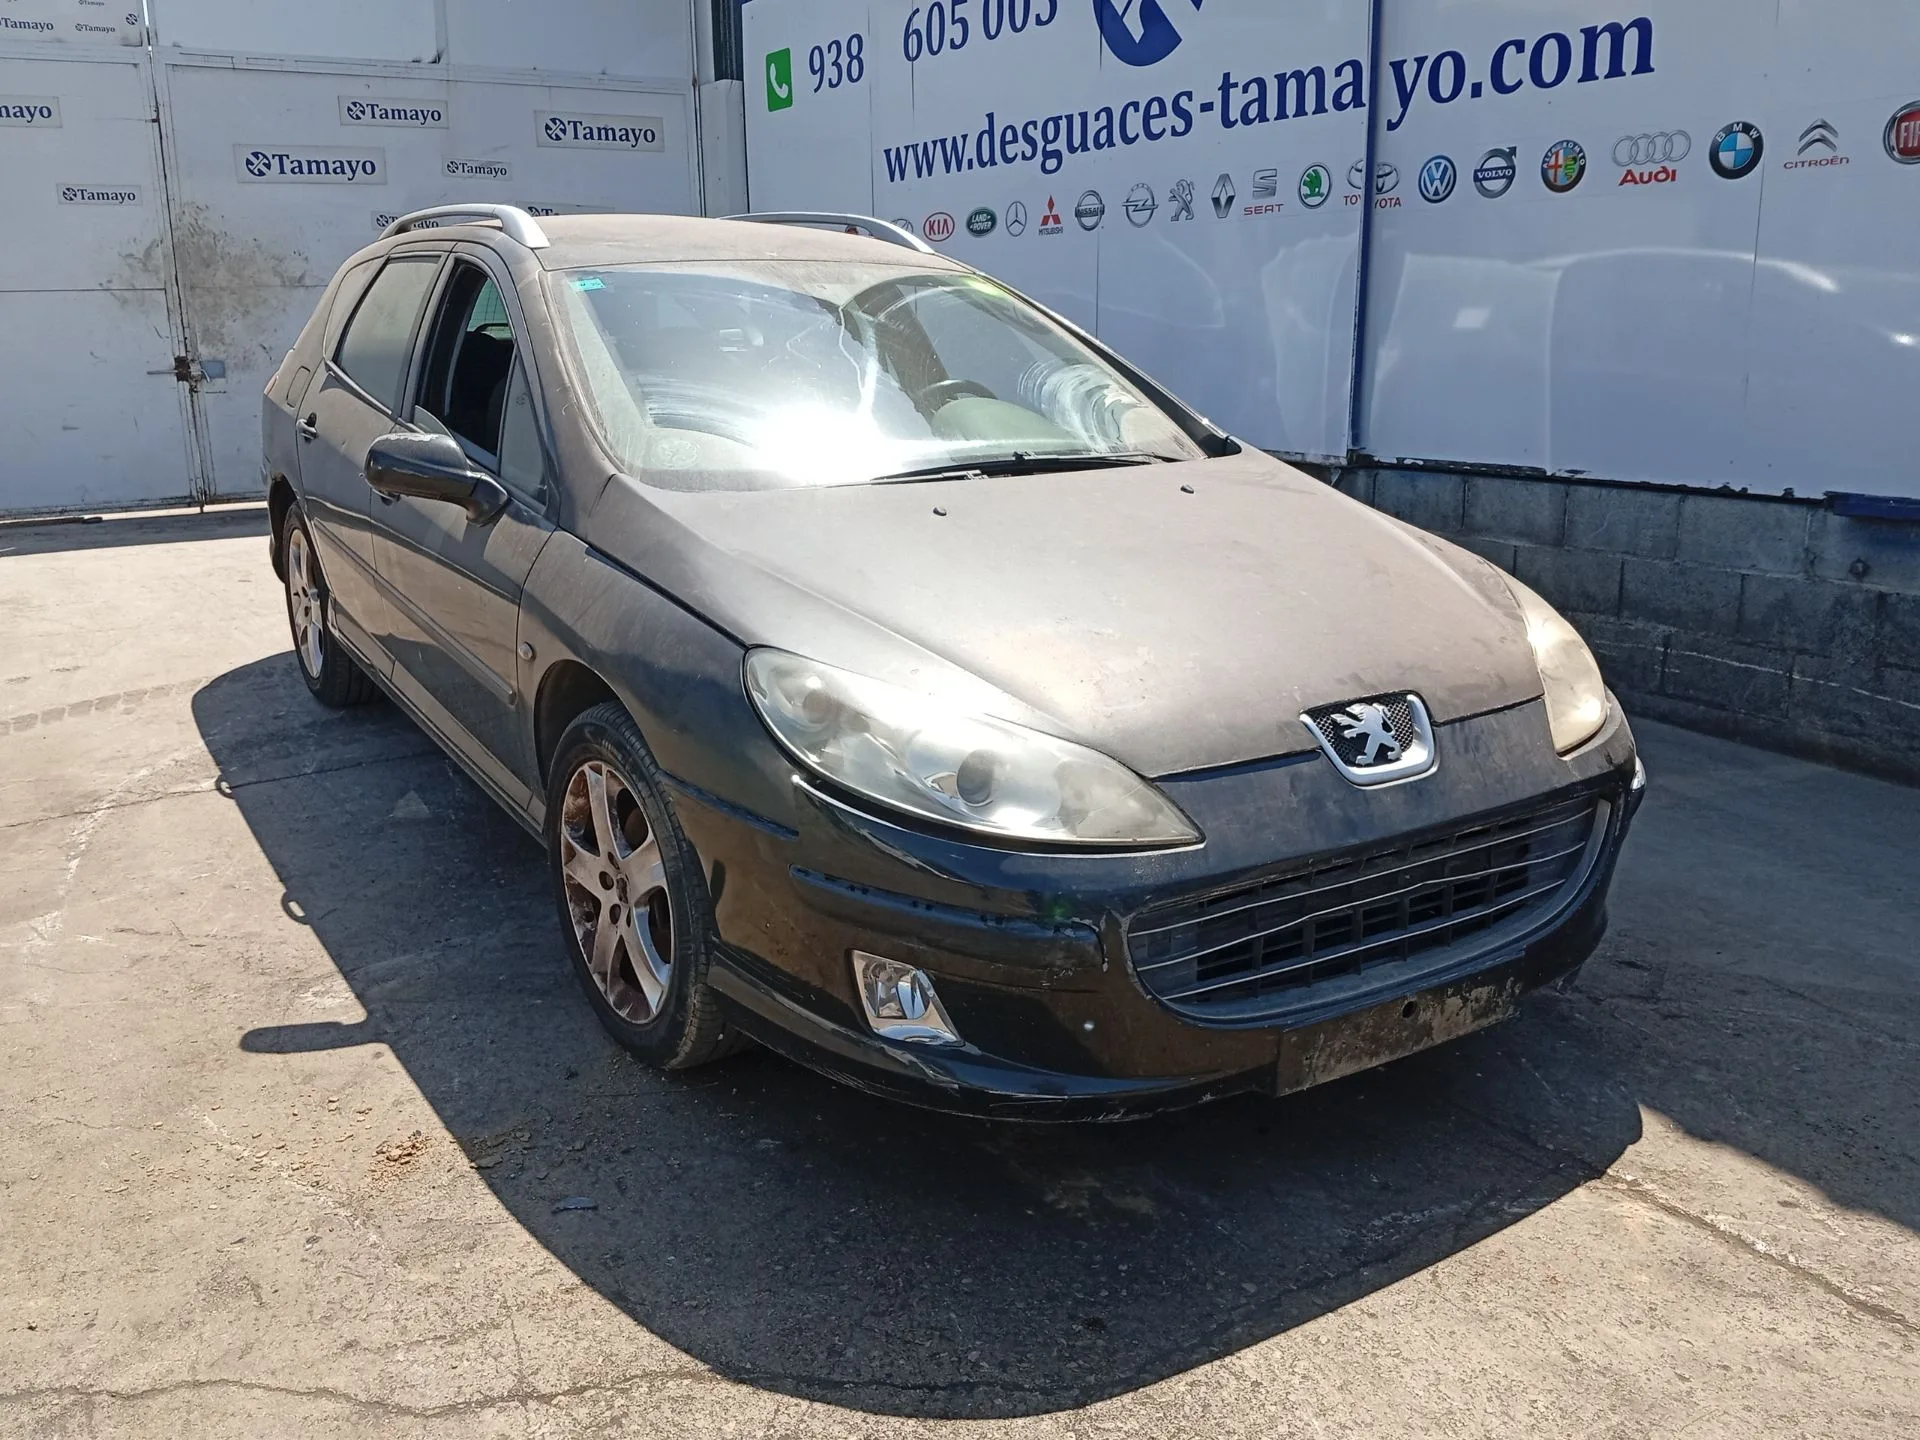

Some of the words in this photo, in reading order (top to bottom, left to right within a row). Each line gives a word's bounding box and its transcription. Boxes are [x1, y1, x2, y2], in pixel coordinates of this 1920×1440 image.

[1, 17, 54, 32] Tamayo
[83, 24, 116, 33] Tamayo
[808, 33, 865, 93] 938
[903, 0, 969, 62] 605
[883, 15, 1656, 183] www.desguaces-tamayo.com
[366, 103, 442, 125] Tamayo
[567, 120, 656, 148] Tamayo
[1715, 122, 1761, 143] BMW
[272, 154, 376, 181] Tamayo
[459, 162, 507, 178] Tamayo
[1477, 168, 1513, 179] VOLVO
[1618, 166, 1678, 186] Audi
[77, 189, 136, 204] Tamayo
[971, 213, 988, 223] LAND
[1243, 203, 1284, 216] SEAT
[928, 218, 950, 236] KIA
[972, 221, 992, 232] ROVER
